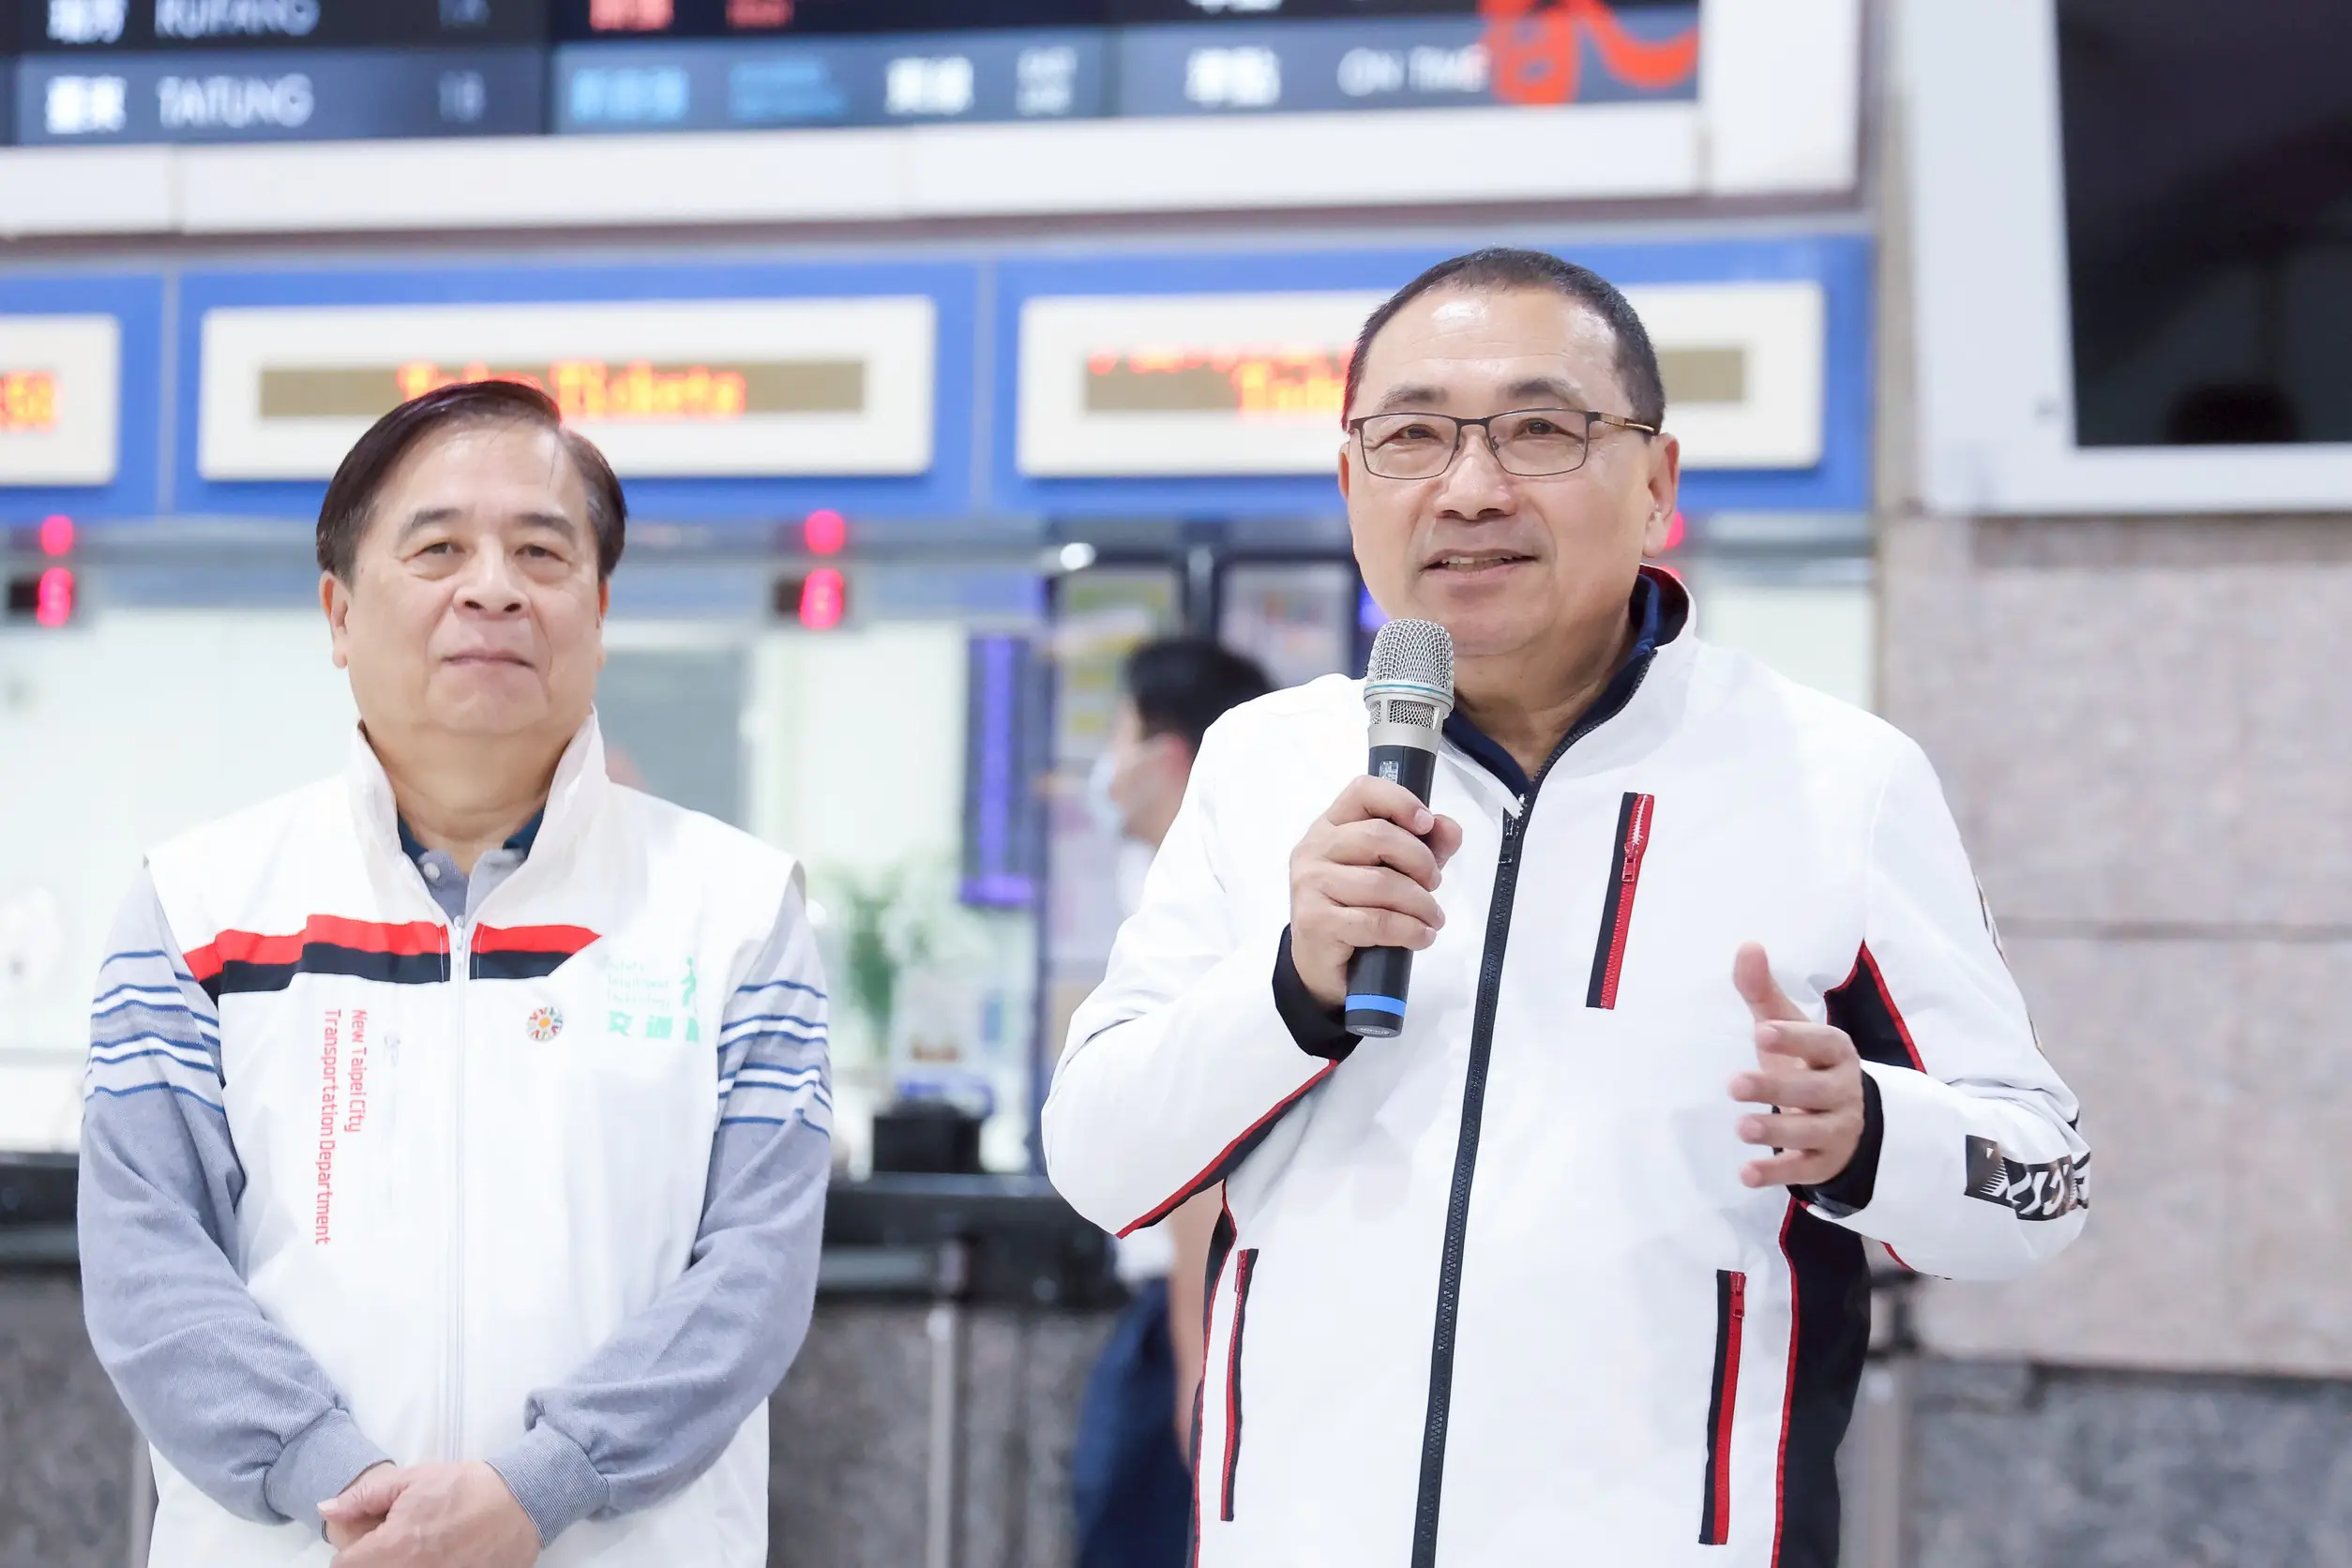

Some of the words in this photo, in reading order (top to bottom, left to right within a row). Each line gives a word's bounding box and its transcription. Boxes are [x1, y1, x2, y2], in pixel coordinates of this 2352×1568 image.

[351, 1009, 368, 1043] New
[320, 1009, 341, 1137] Transportation
[347, 1047, 367, 1095] Taipei
[343, 1099, 366, 1132] City
[315, 1139, 336, 1245] Department
